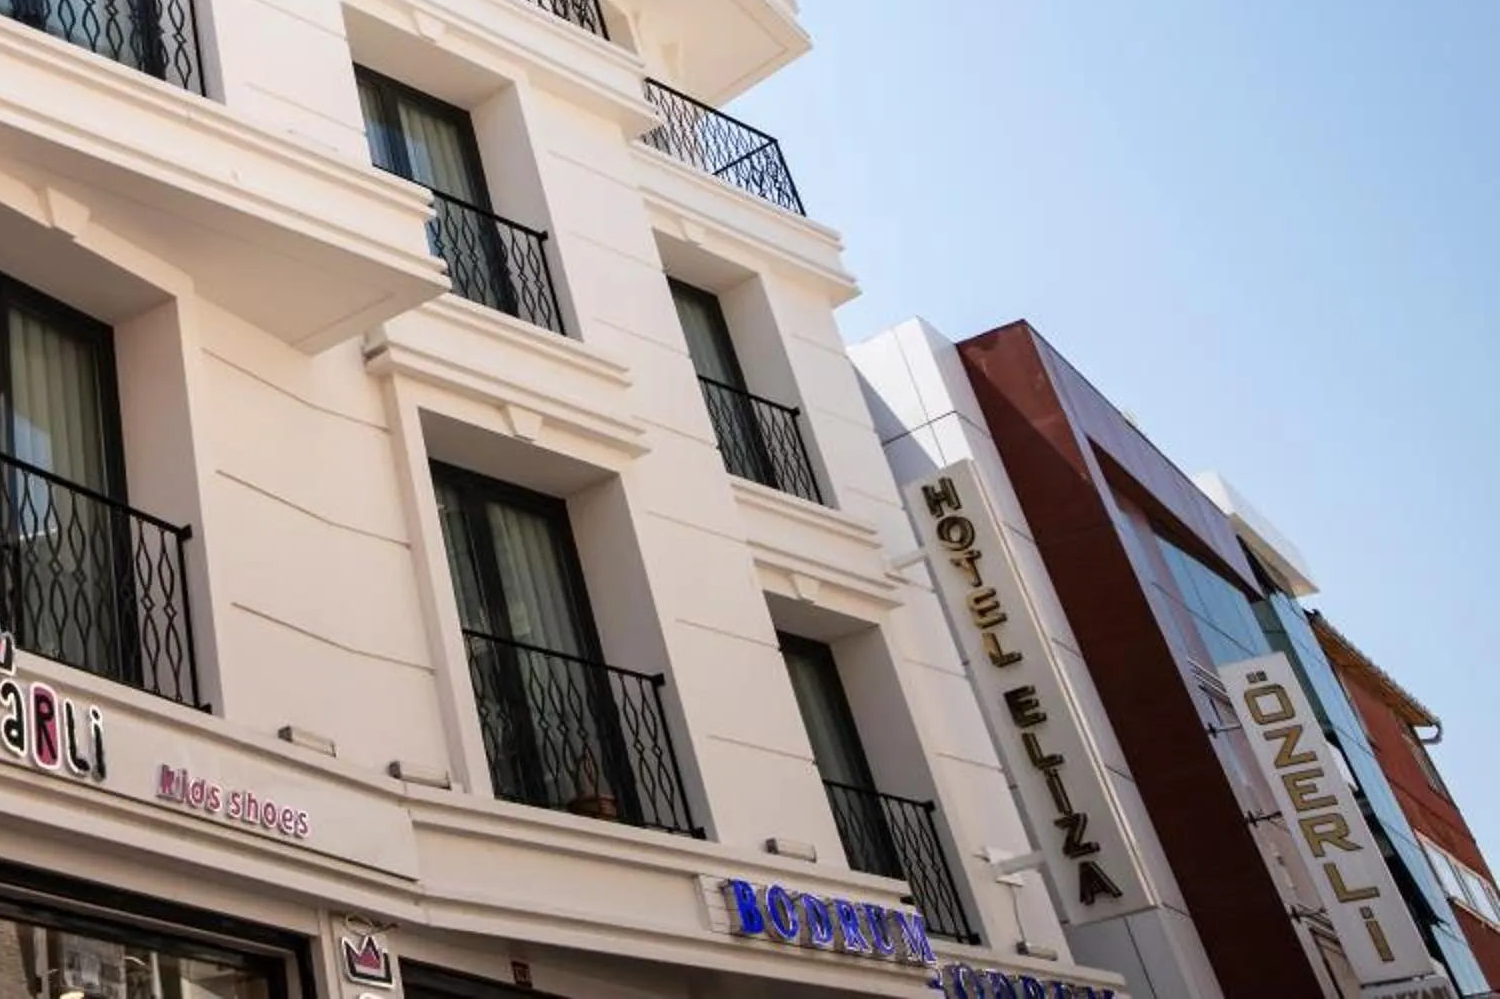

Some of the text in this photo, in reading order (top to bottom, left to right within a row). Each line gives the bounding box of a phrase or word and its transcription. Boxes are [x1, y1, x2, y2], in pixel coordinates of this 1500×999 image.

[921, 476, 1024, 669] HOTEL
[159, 763, 311, 839] kids shoes
[1244, 669, 1395, 963] ÖZERLİ
[726, 877, 938, 965] BODRUM
